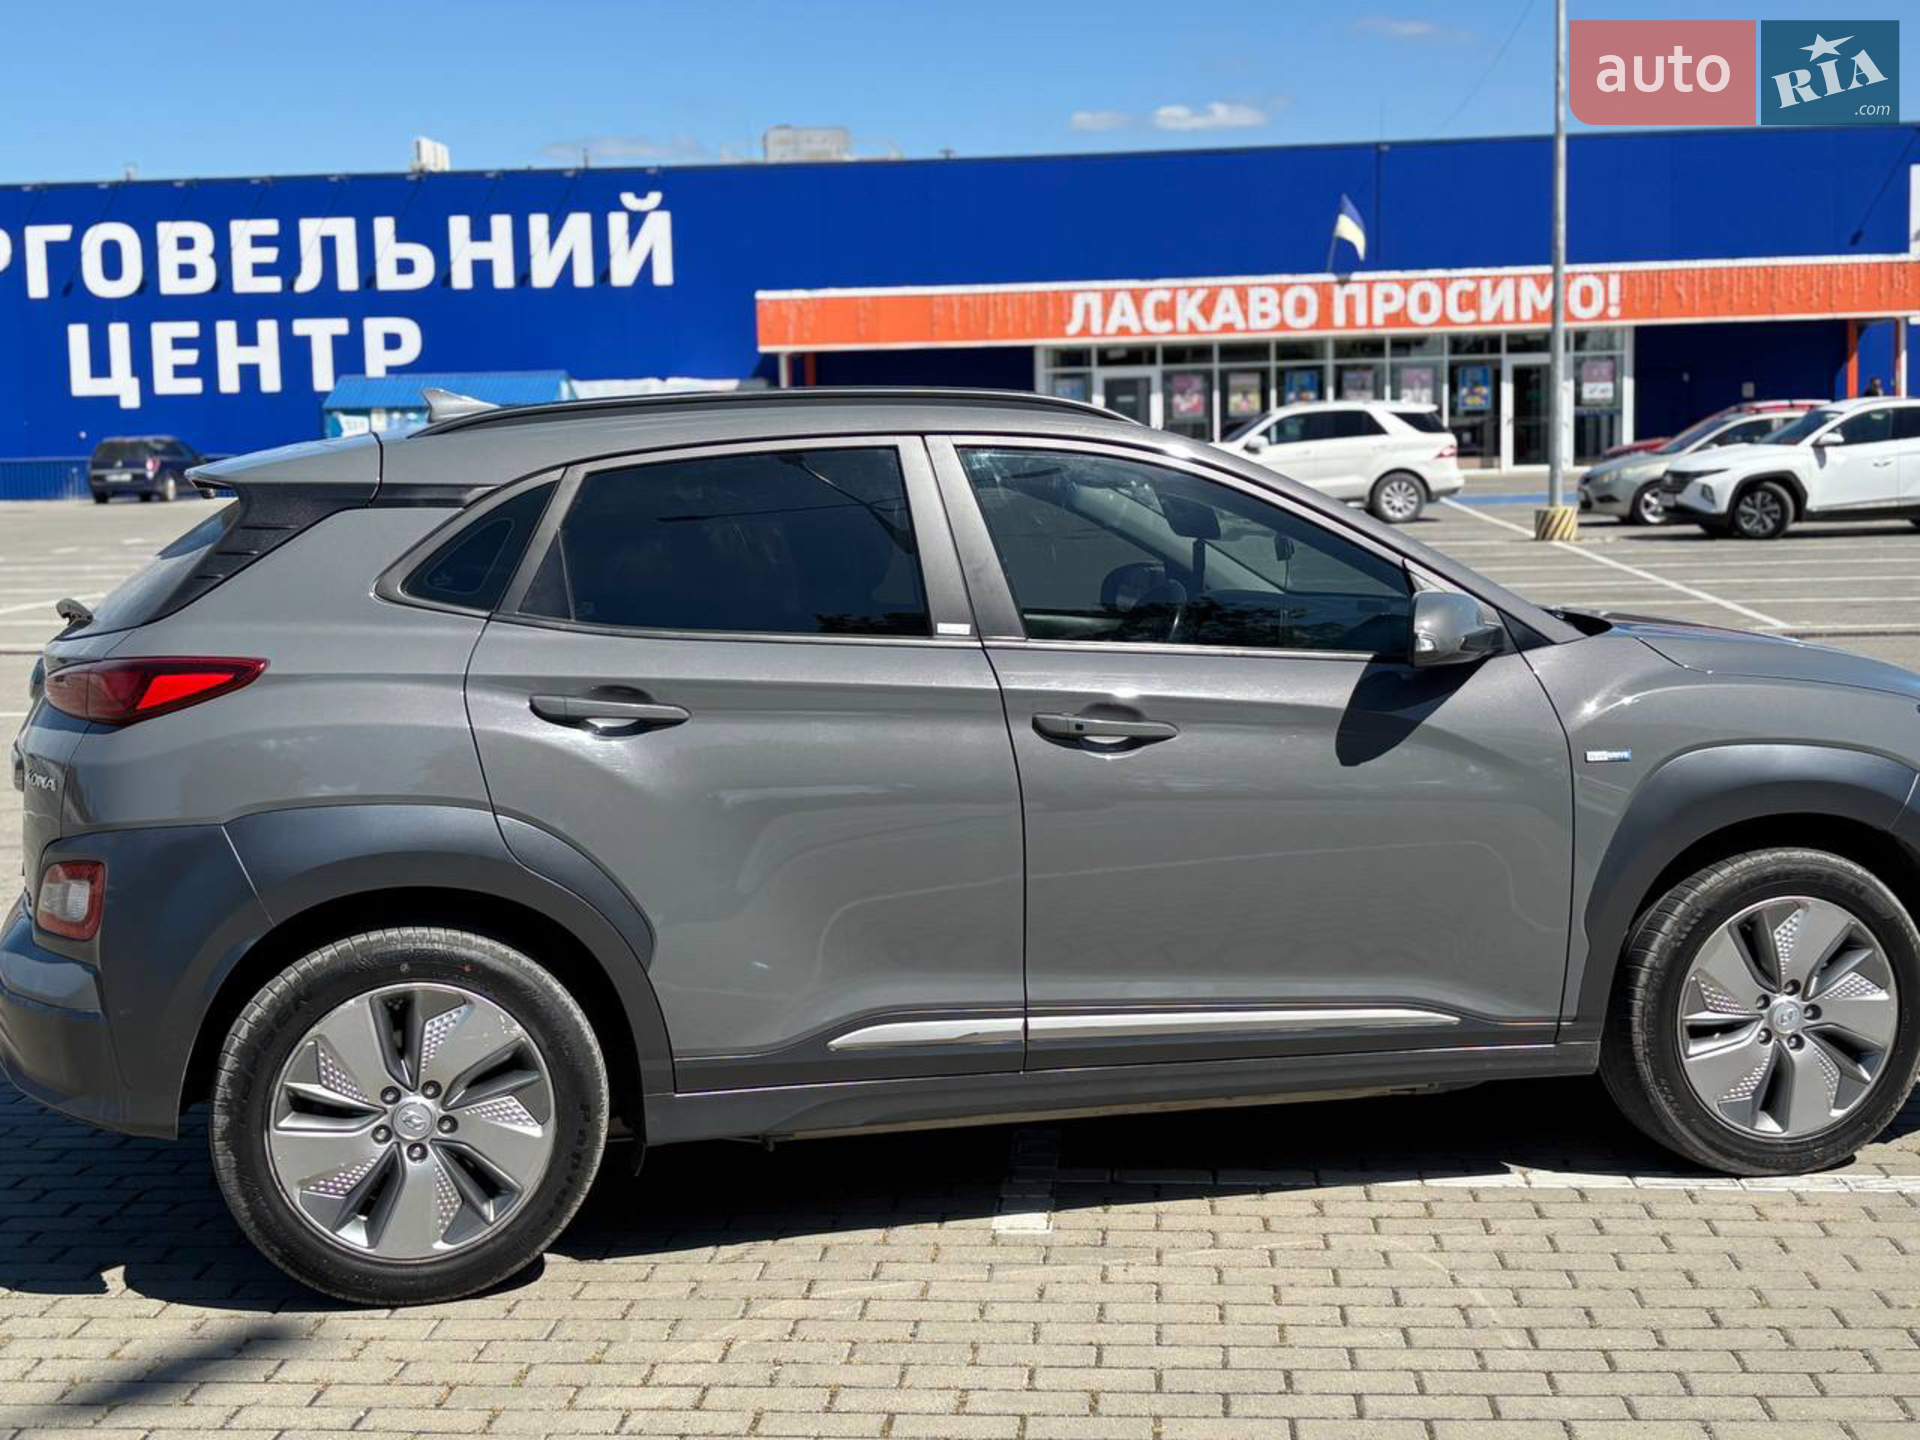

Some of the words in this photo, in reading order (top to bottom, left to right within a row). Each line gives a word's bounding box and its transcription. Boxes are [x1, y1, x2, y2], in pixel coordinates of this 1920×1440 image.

[1065, 285, 1319, 337] ЛАСКАВО
[1332, 272, 1621, 329] ПРОСИМО!
[67, 316, 423, 409] ЦЕНТР
